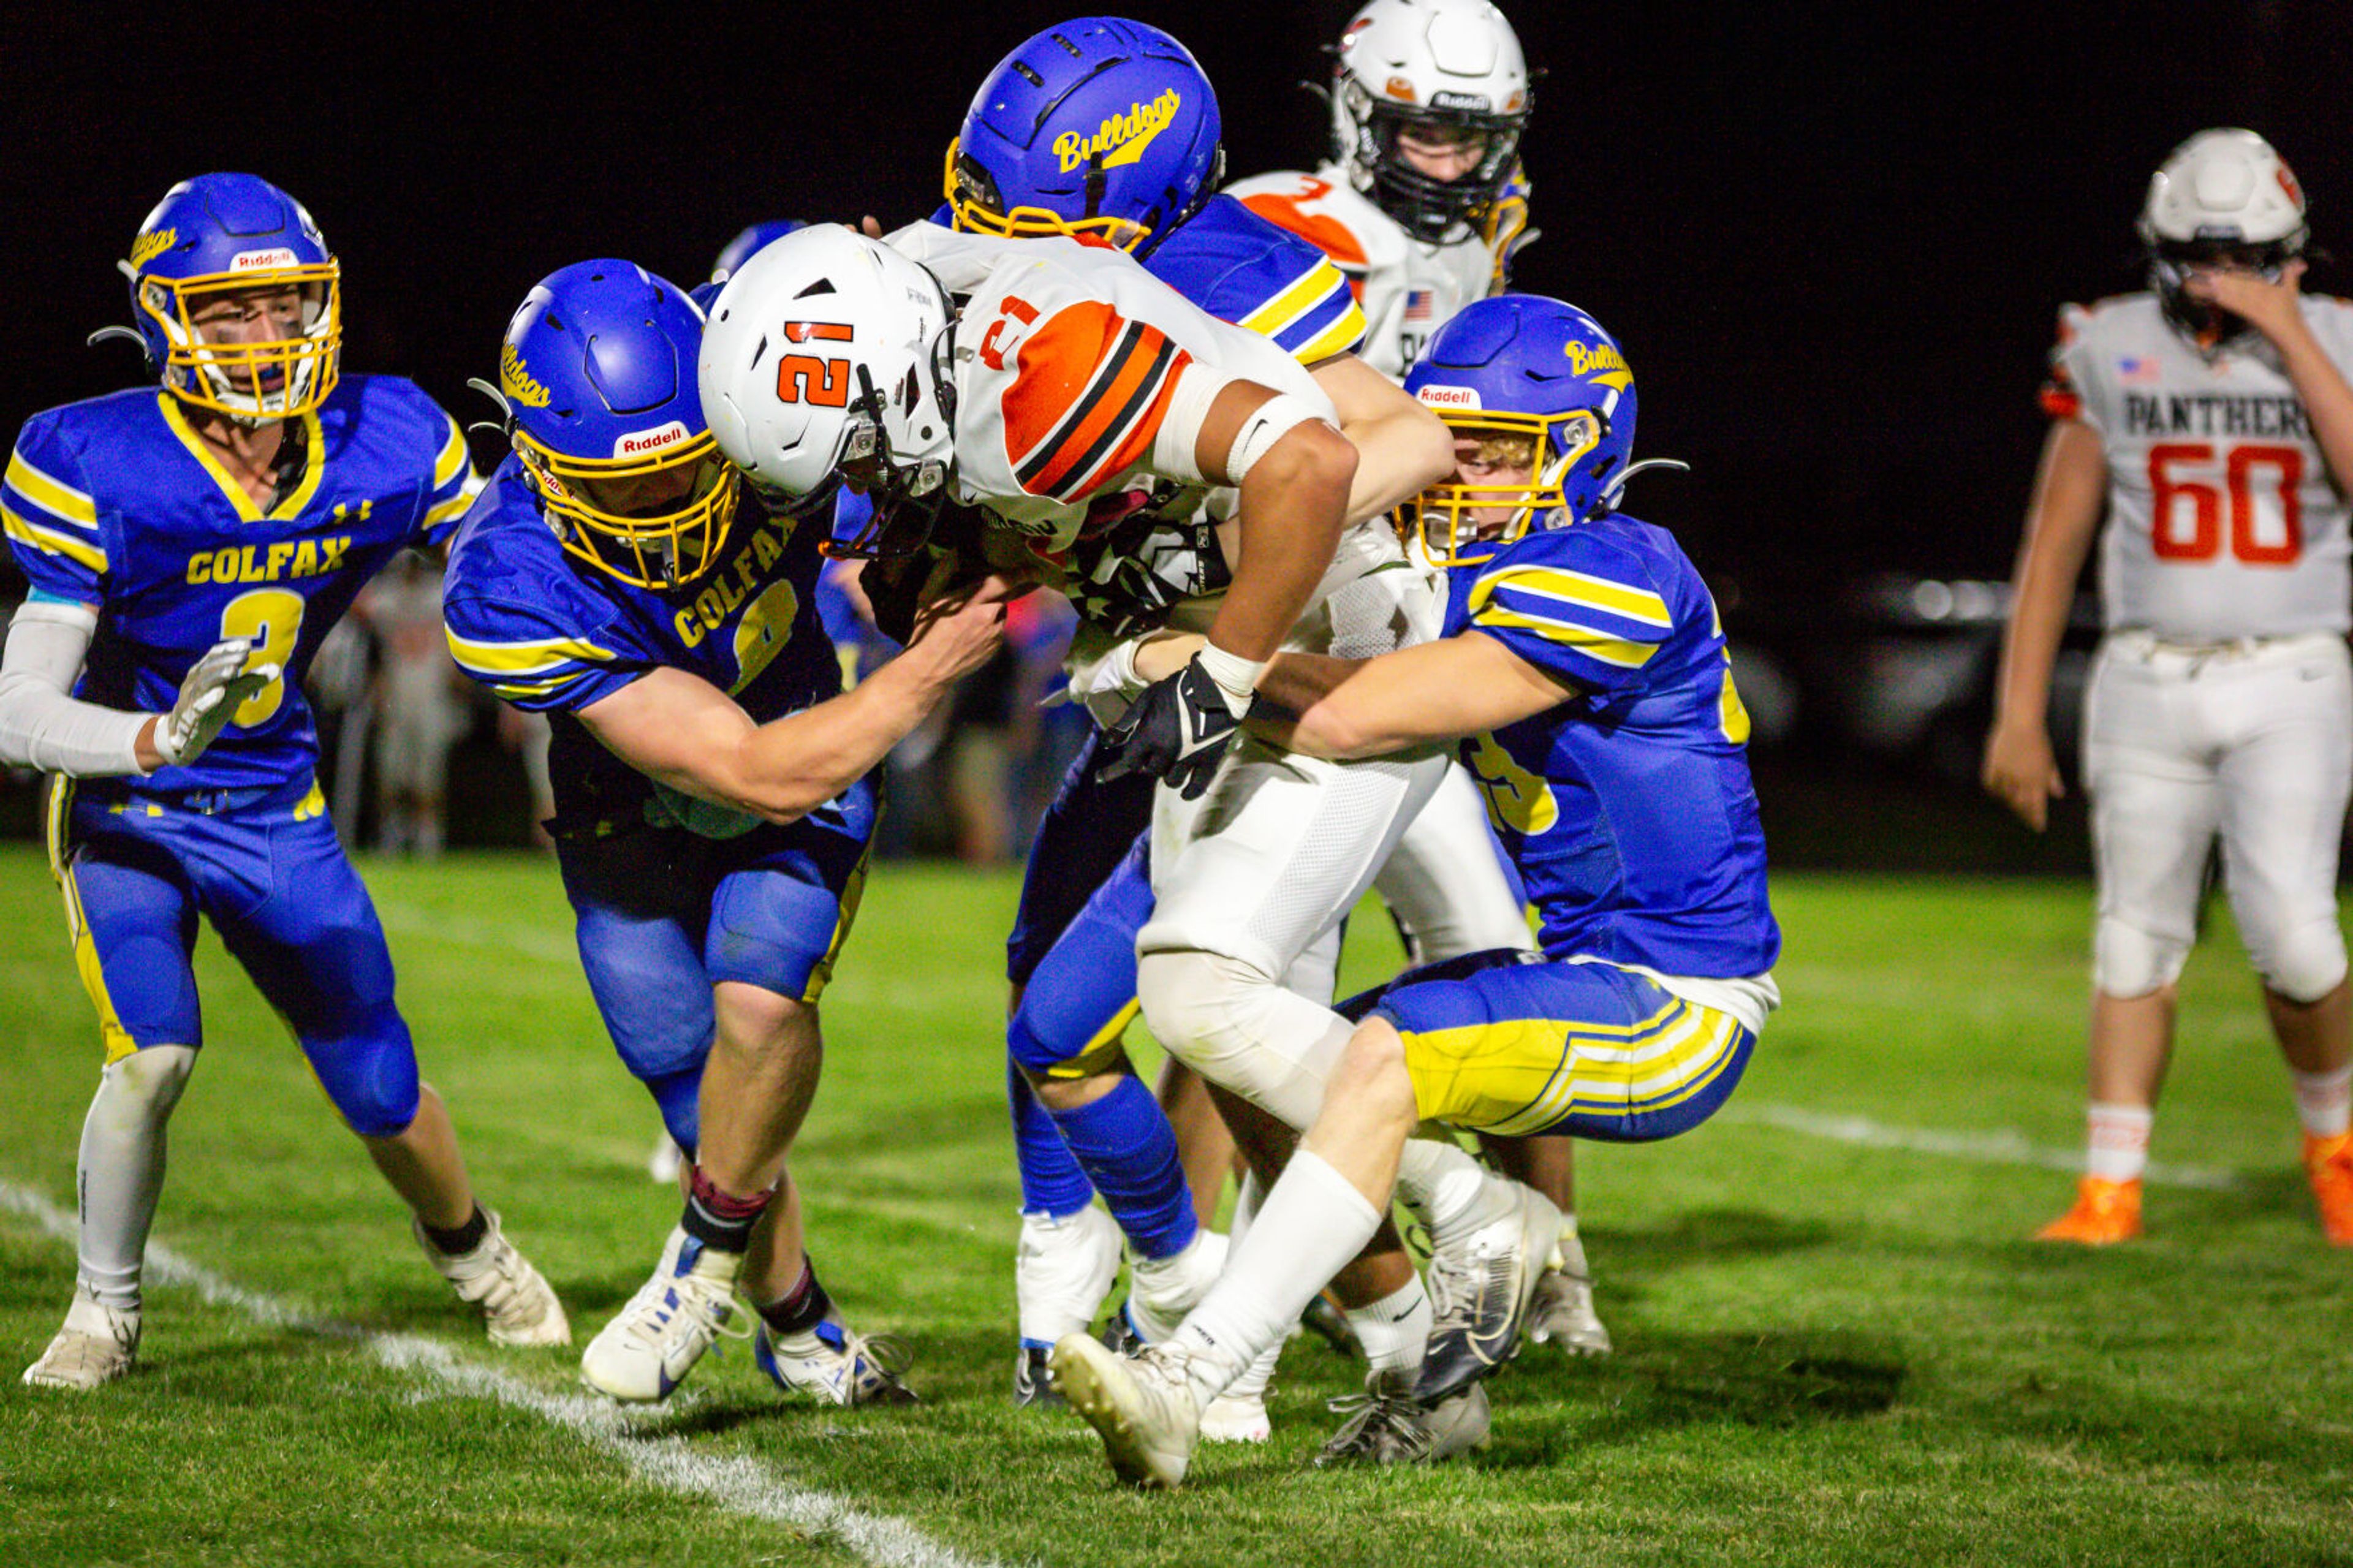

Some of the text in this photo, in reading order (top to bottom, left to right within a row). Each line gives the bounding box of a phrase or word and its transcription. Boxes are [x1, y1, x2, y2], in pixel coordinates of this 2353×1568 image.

[1052, 88, 1180, 173] Bulldogs
[776, 320, 854, 407] 21
[1420, 388, 1471, 404] Riddell
[624, 428, 681, 452] Riddell
[2126, 396, 2306, 433] PANTHER
[2147, 444, 2304, 564] 60
[186, 536, 352, 585] COLFAX
[218, 586, 306, 729] 3
